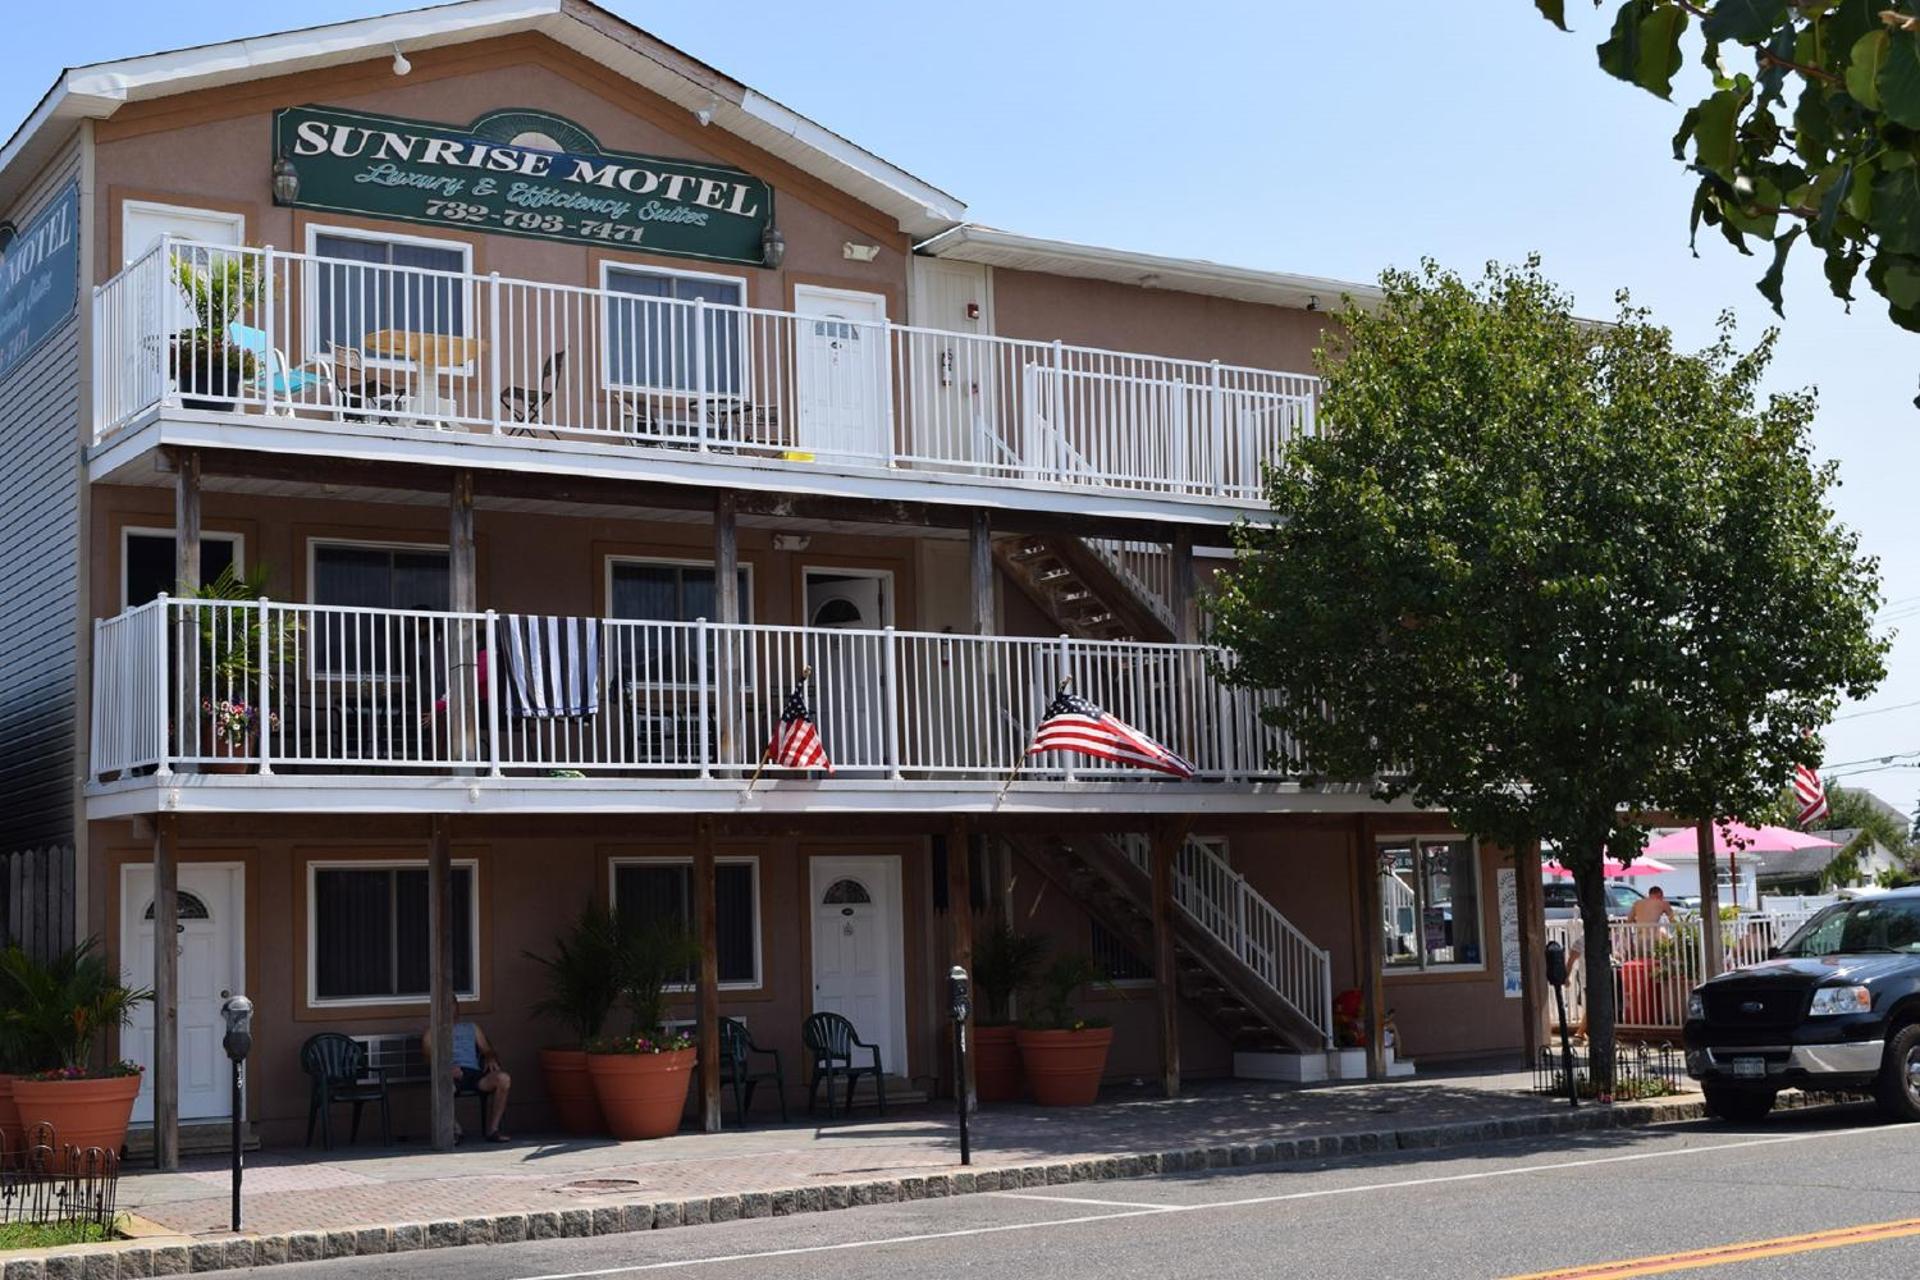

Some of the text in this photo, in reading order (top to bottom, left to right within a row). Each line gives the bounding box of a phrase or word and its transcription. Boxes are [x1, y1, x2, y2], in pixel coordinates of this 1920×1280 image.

[294, 121, 758, 218] SUNRISE MOTEL
[354, 163, 709, 226] Luxury & Efficiency Suites
[5, 201, 72, 292] MOTEL
[425, 199, 645, 244] 732-793-7471
